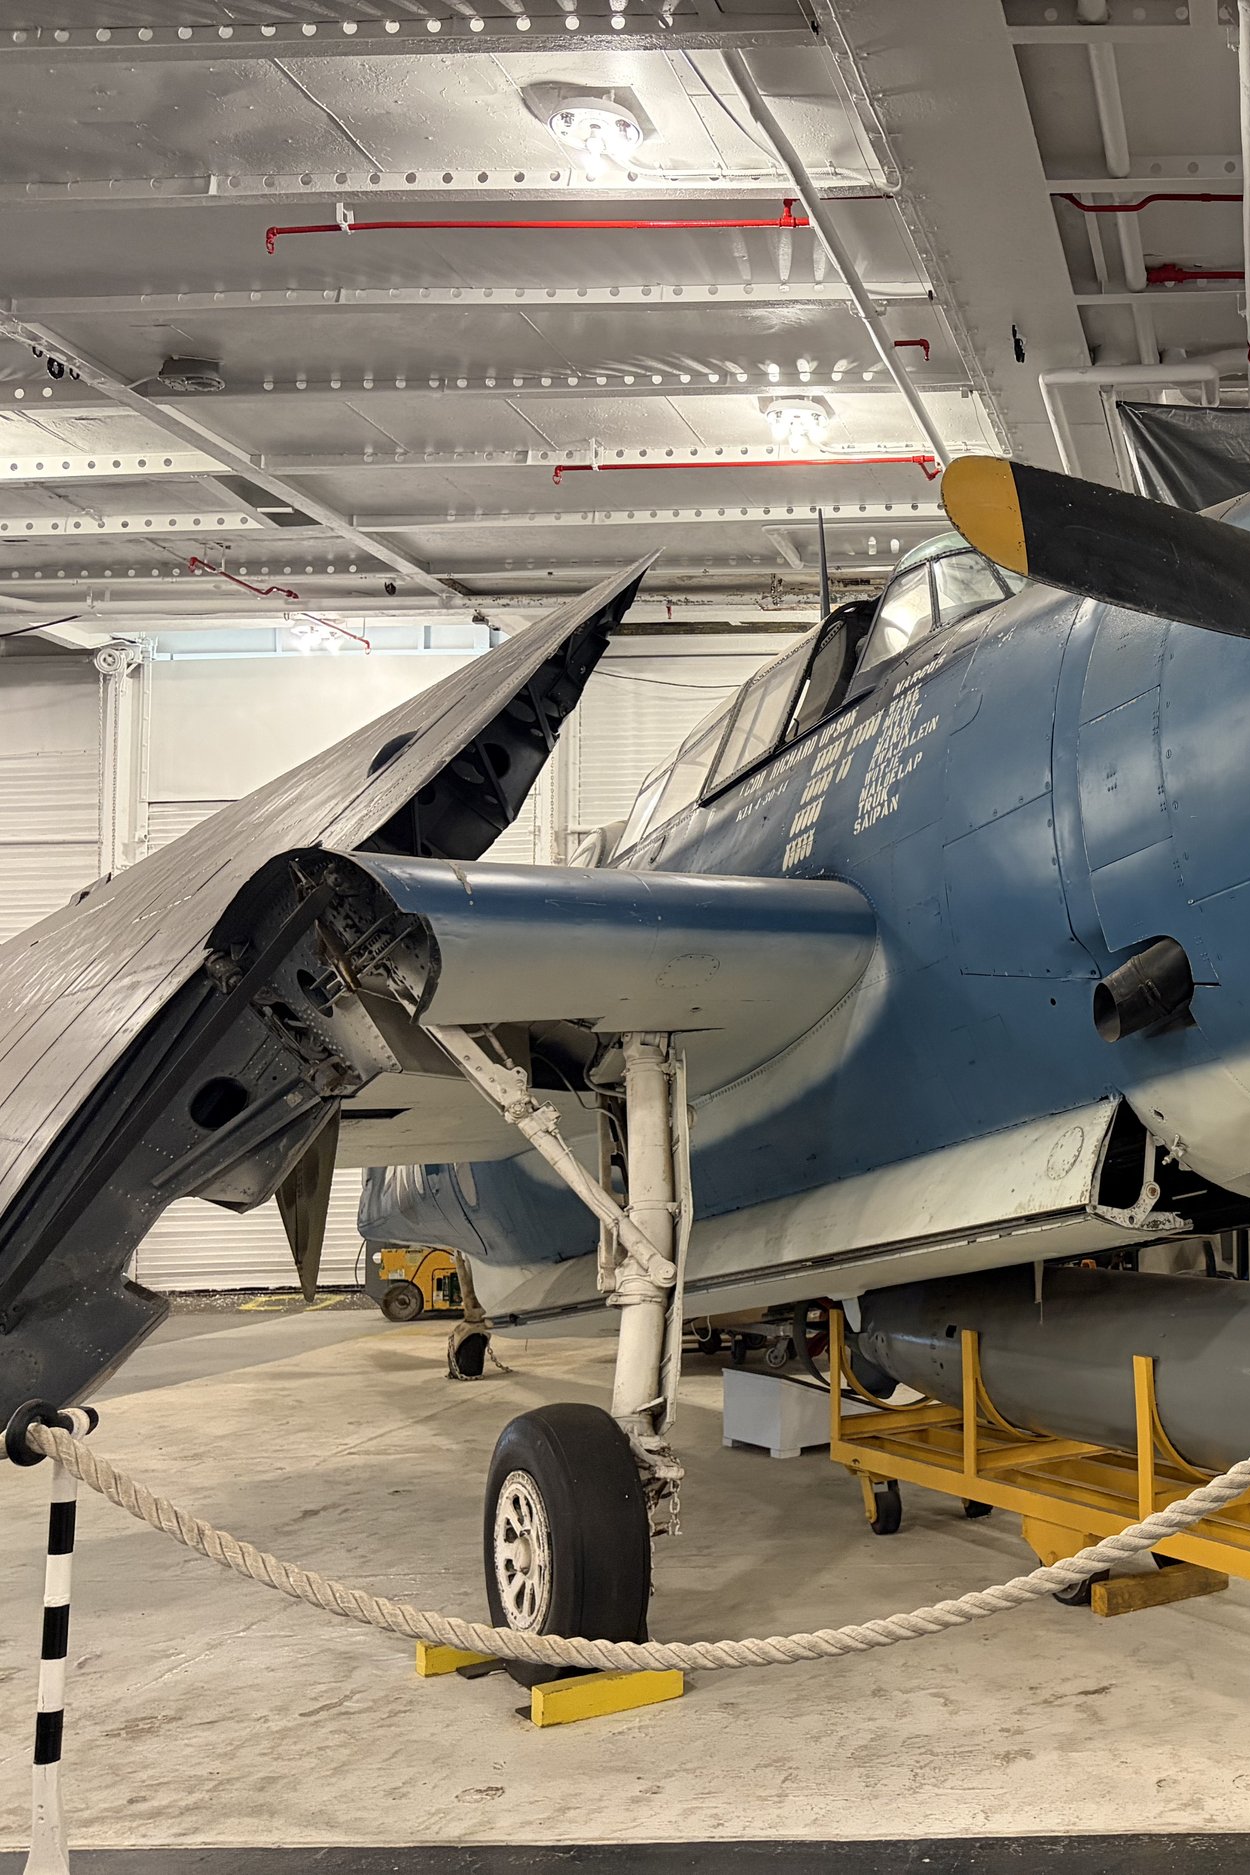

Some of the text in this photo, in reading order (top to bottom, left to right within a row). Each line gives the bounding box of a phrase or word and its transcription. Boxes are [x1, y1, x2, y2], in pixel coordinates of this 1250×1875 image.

[892, 653, 947, 697] MARCUS
[888, 682, 922, 715] WAKE
[769, 735, 818, 781] RICHARD
[818, 706, 859, 748] UPSON
[868, 714, 940, 772] KWAJALEIN
[872, 720, 912, 758] MAKIN
[878, 703, 922, 743] JALUIT
[859, 751, 923, 801] MALOELAP
[864, 752, 902, 786] WOTJE
[853, 793, 899, 836] SAIPAN
[858, 784, 890, 817] TRUK
